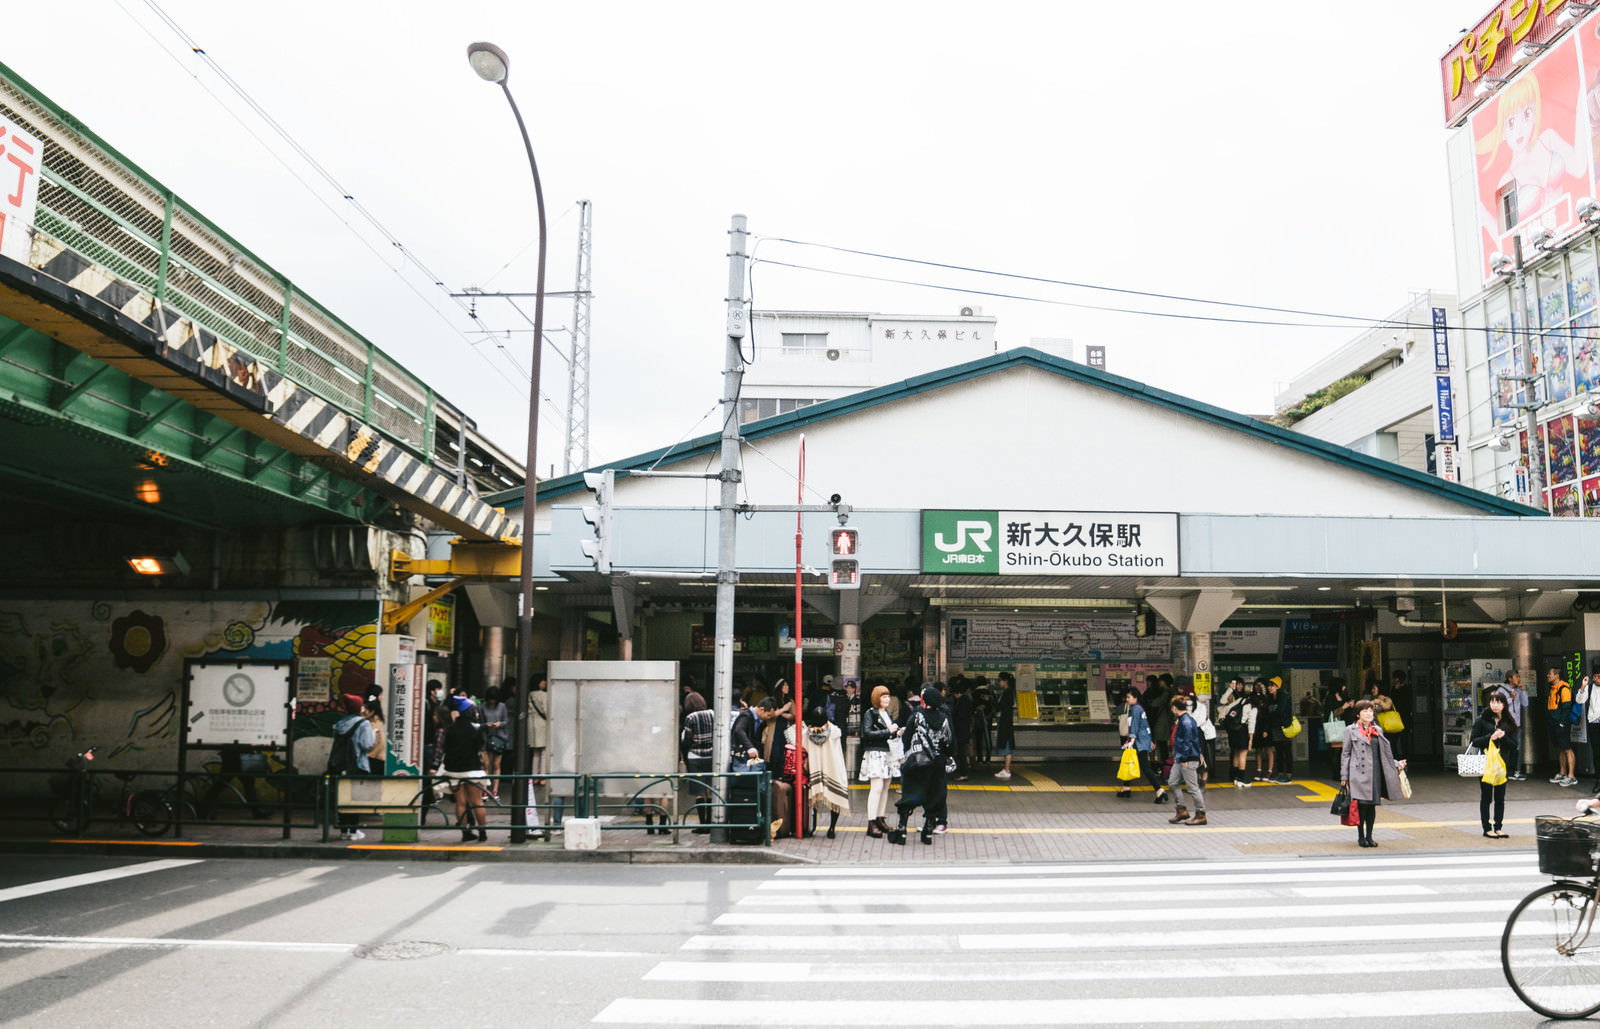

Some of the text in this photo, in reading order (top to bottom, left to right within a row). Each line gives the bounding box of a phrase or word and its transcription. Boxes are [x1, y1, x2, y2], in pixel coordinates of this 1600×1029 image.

[884, 328, 982, 341] 新大久保ビル
[934, 520, 992, 552] JR
[1006, 522, 1142, 548] 新大久保駅
[942, 554, 985, 565] JR東日本
[1006, 550, 1164, 567] Shin-Ōkubo Station
